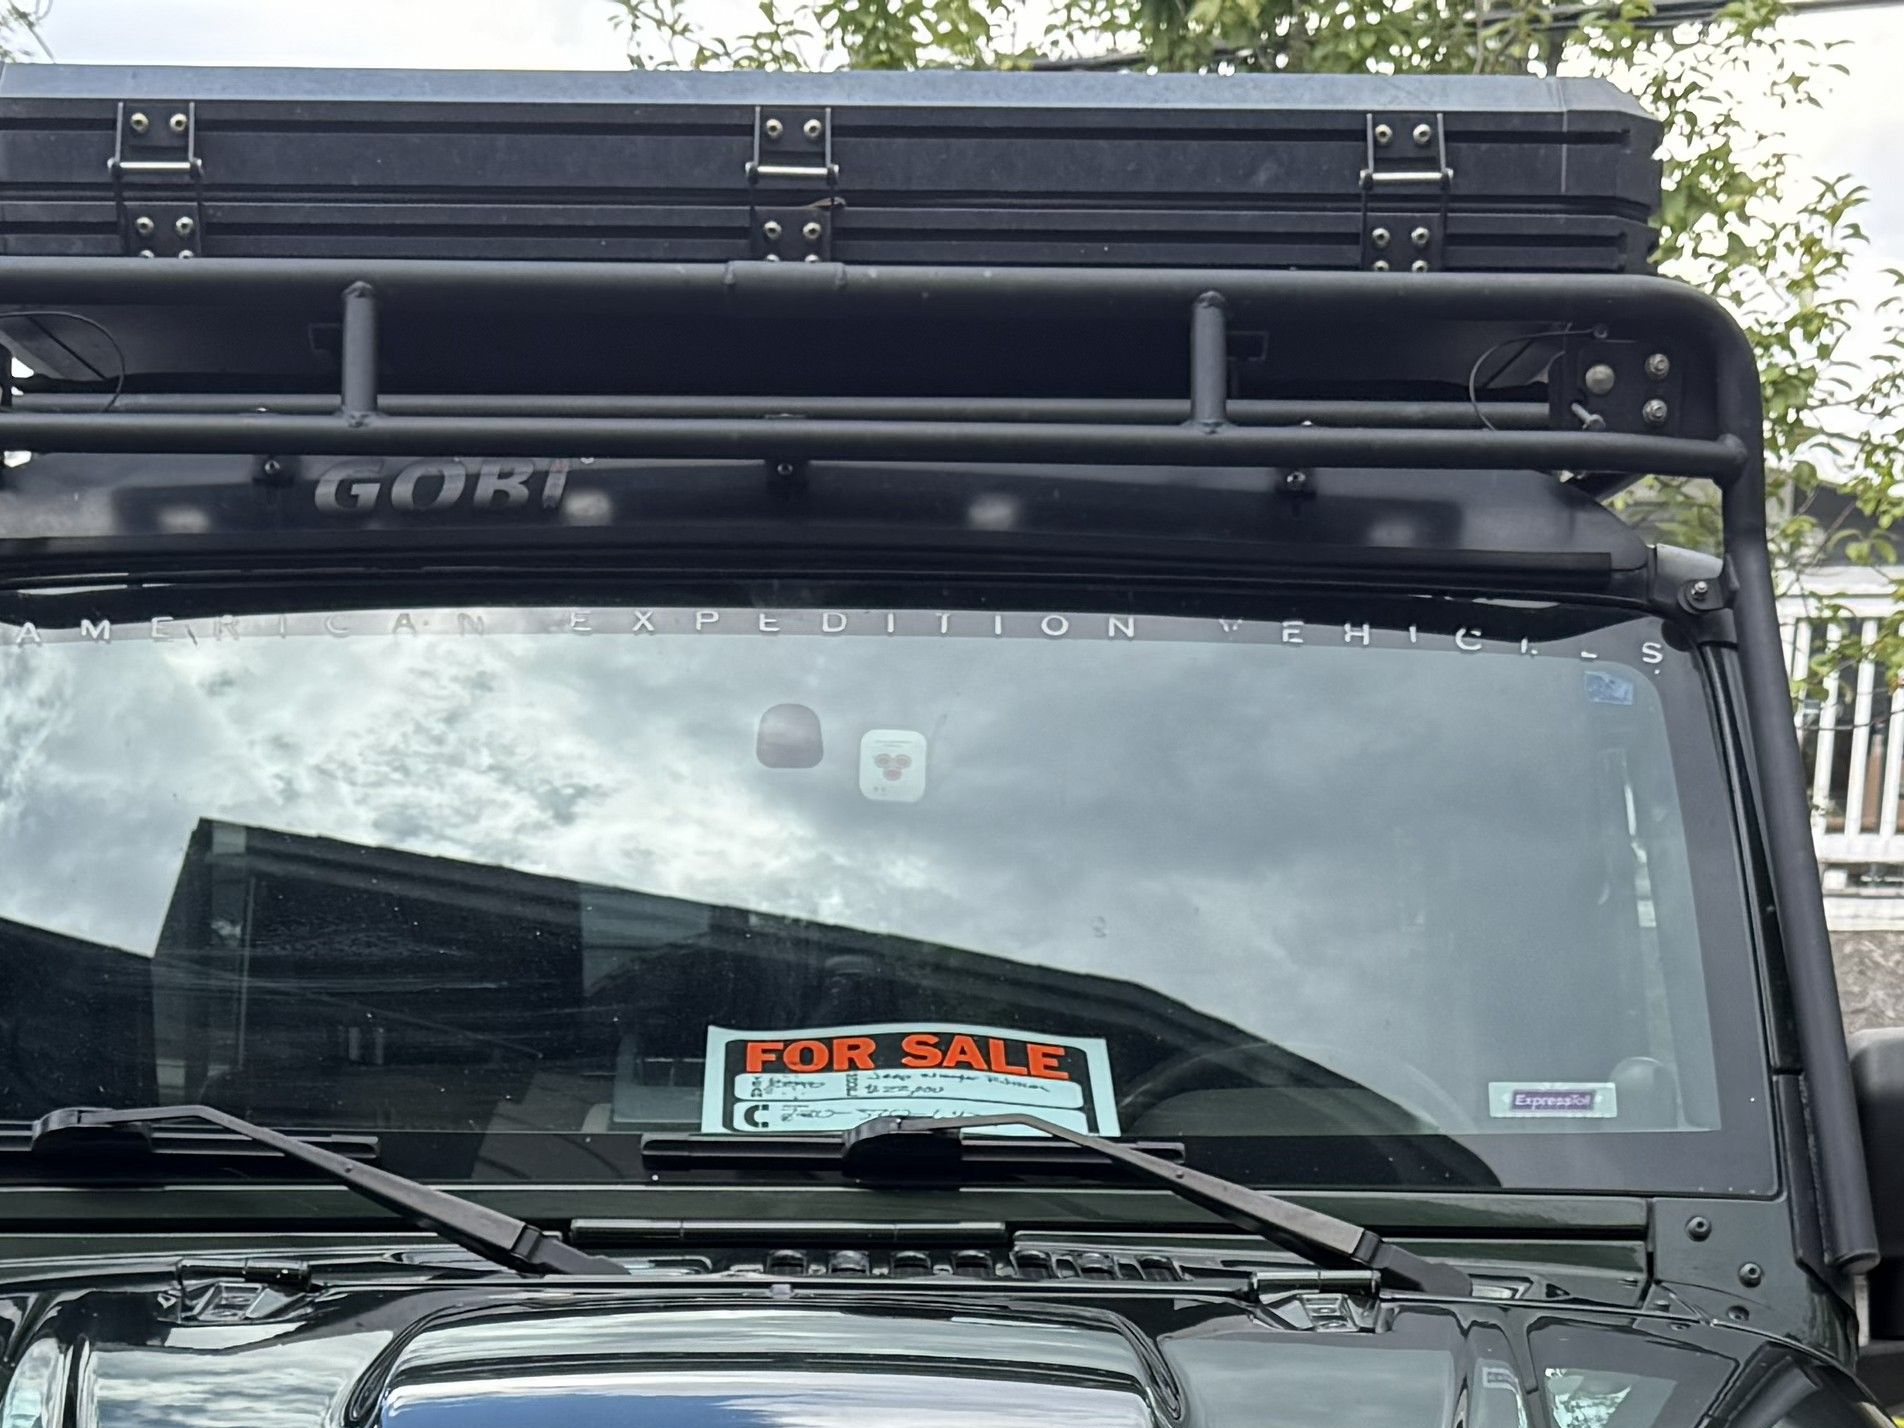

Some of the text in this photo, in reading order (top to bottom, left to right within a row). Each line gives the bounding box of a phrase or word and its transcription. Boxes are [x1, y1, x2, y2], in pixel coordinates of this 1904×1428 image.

[314, 457, 570, 512] GOBI
[16, 610, 1665, 665] AMERICAN EXPEDITION VEHICLS
[745, 1034, 1070, 1080] FOR SALE
[1514, 1093, 1591, 1110] ExpressToll
